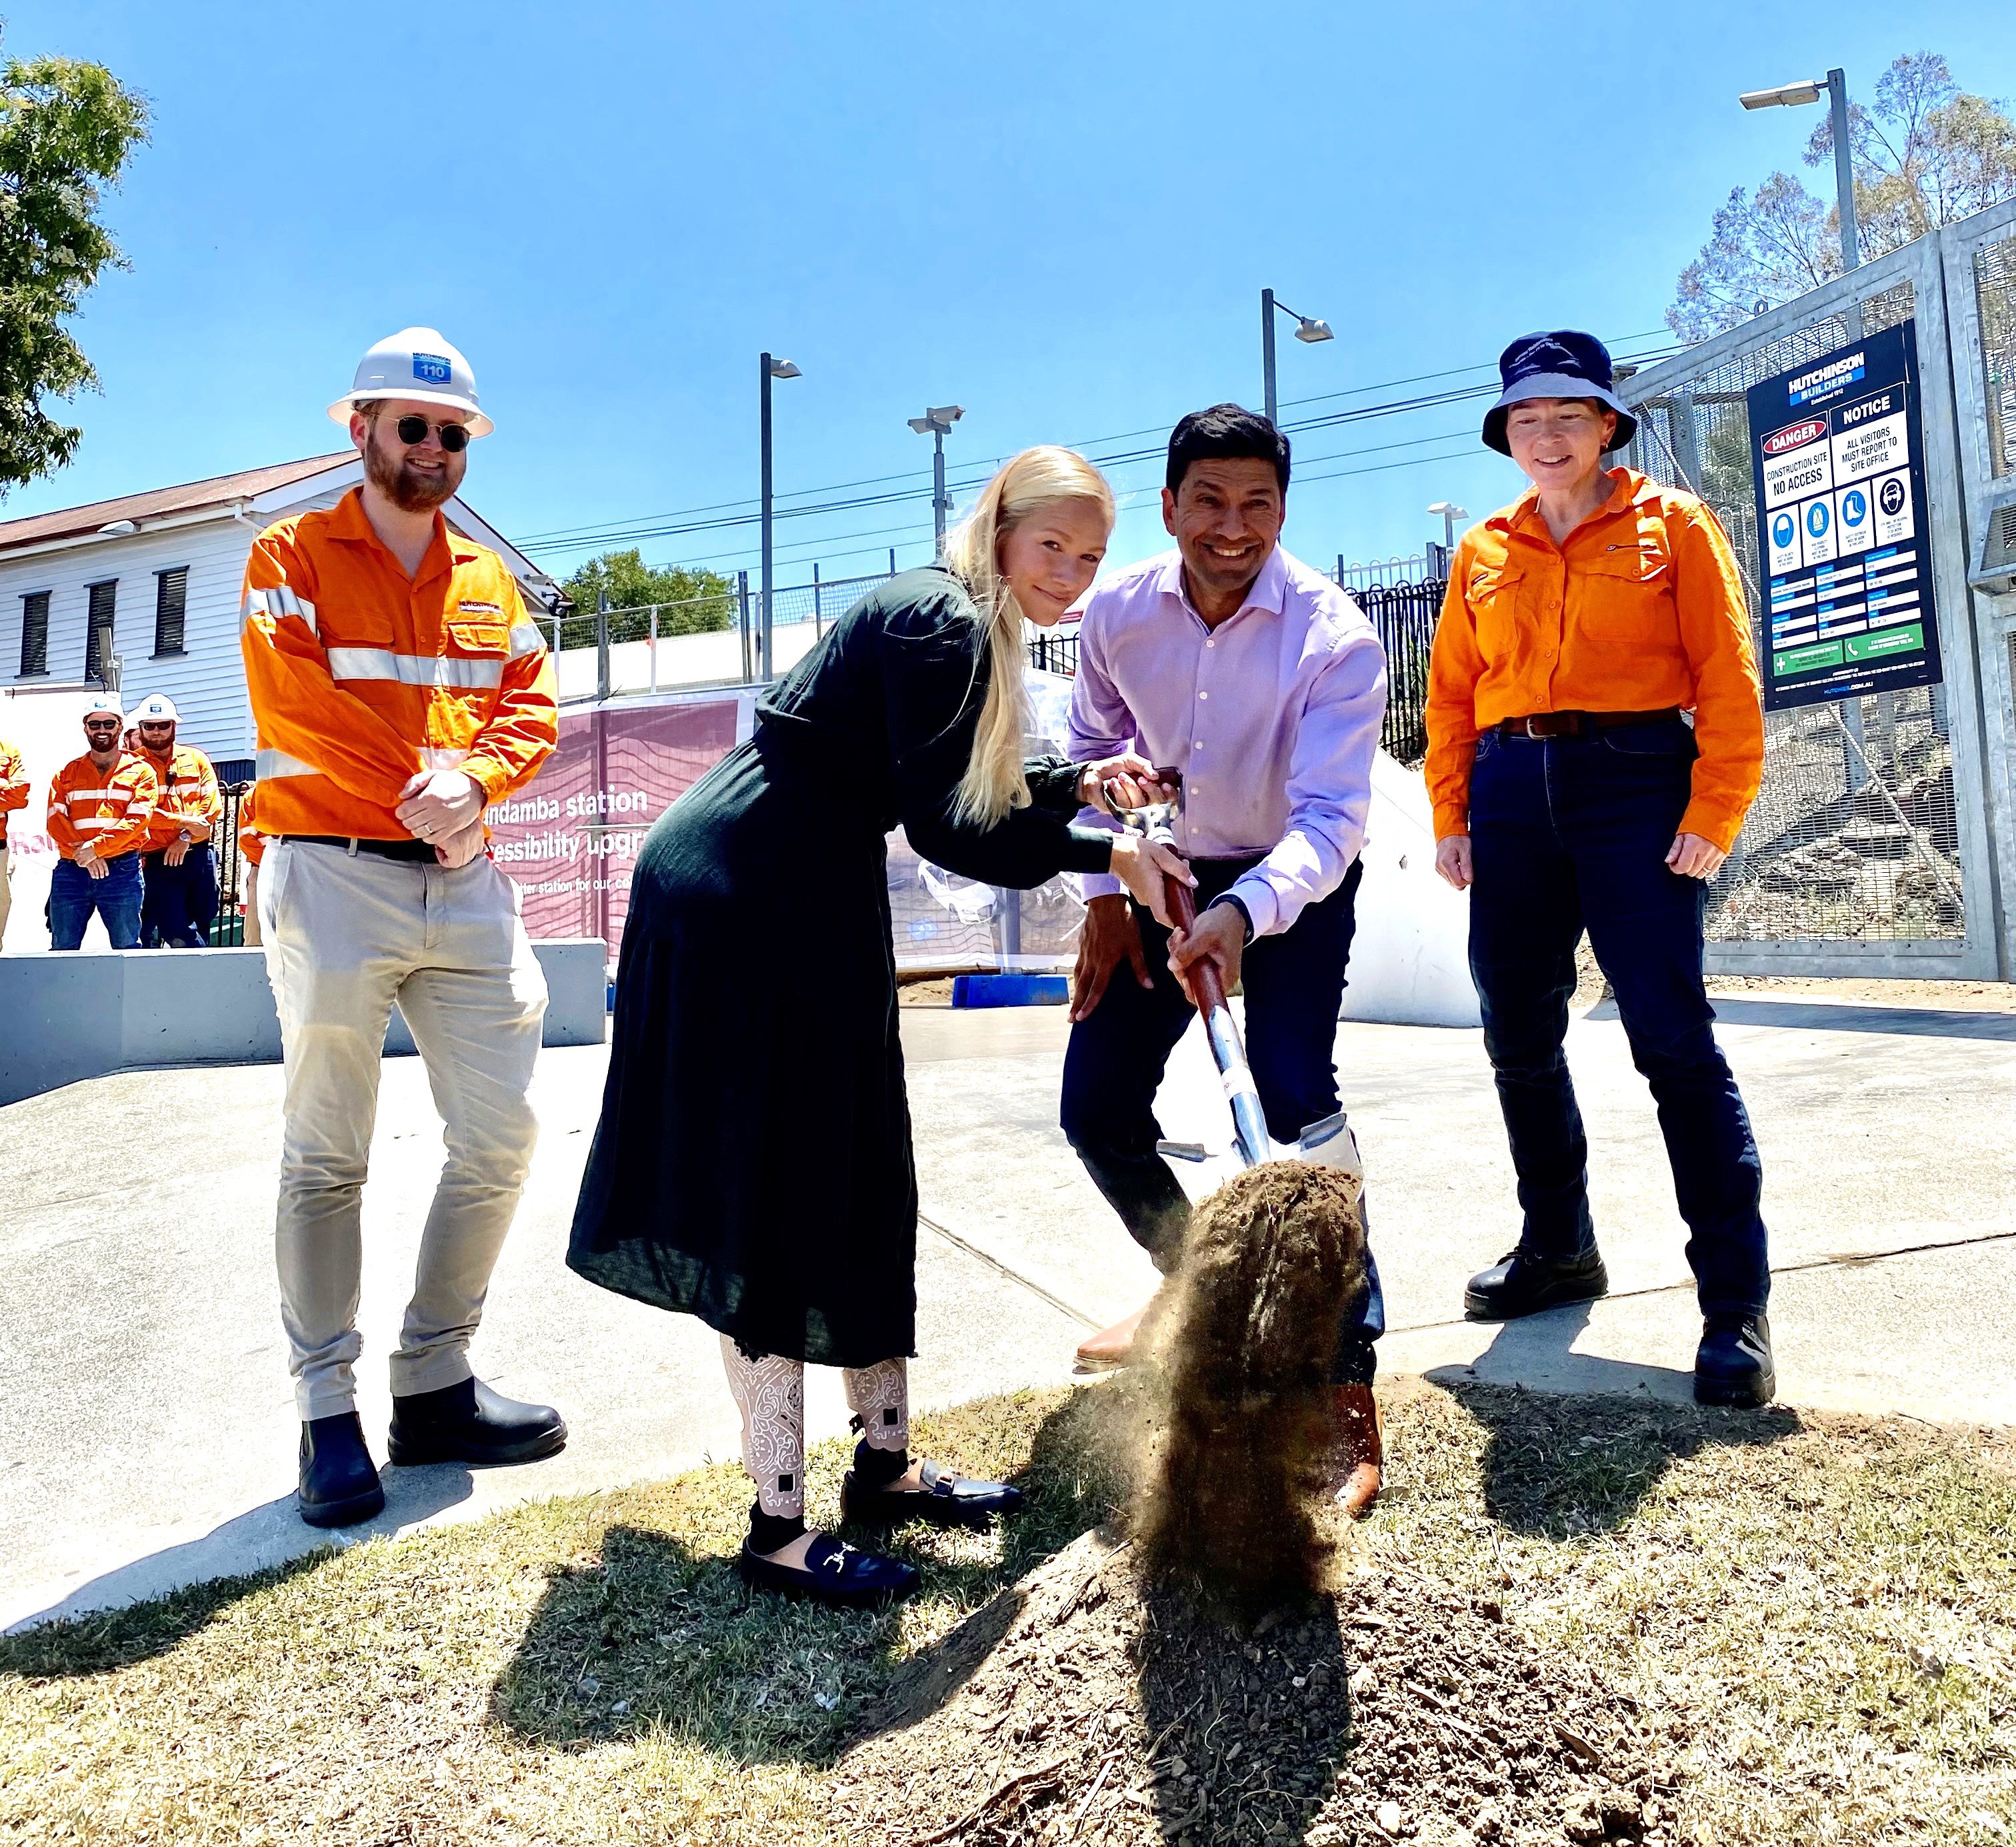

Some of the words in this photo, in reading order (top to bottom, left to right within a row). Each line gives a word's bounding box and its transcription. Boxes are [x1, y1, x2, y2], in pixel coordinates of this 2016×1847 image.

[421, 364, 445, 378] 110
[1788, 351, 1865, 395] HUTCHINSON
[1801, 372, 1853, 400] BUILDERS
[1843, 395, 1891, 425] NOTICE
[1771, 423, 1817, 451] DANGER
[1842, 449, 1860, 463] MUST
[1861, 439, 1886, 457] REPORT
[1888, 436, 1897, 447] TO
[1847, 438, 1859, 450] ALL
[1860, 426, 1890, 445] VISITORS
[1767, 457, 1812, 481] CONSTRUCTION
[1813, 451, 1827, 465] SITE
[1851, 459, 1865, 473] SITE
[1866, 451, 1889, 467] OFFICE
[1773, 480, 1785, 496] NO
[1788, 467, 1823, 491] ACCESS
[565, 784, 647, 817] station
[9, 831, 59, 855] Rai
[586, 831, 651, 860] upgr
[538, 878, 573, 893] station
[575, 877, 591, 891] for
[593, 879, 612, 890] our
